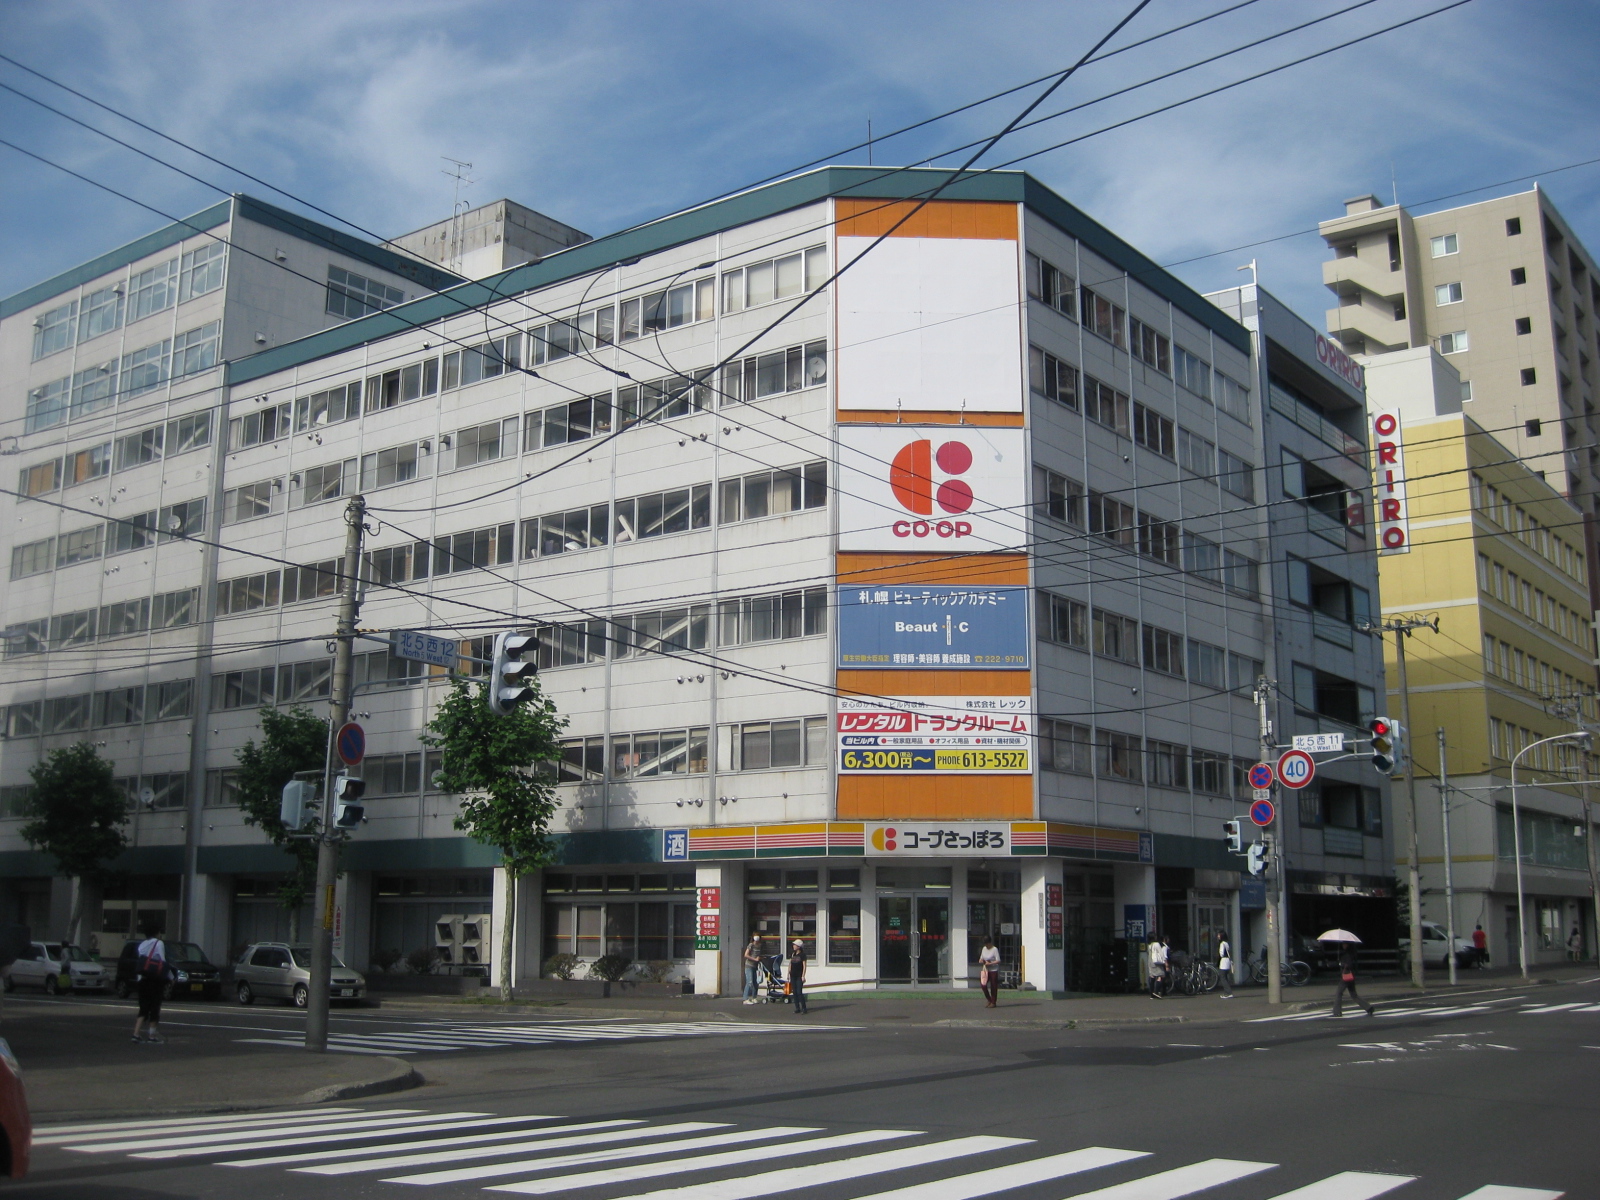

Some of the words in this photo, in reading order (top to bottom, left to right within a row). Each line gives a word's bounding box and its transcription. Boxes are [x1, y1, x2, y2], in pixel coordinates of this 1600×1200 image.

[1316, 334, 1362, 389] ORIRO
[1374, 413, 1405, 549] ORIRO
[859, 590, 889, 605] 札幌
[894, 590, 1007, 606] ビューティックアカデミー
[403, 648, 420, 658] North
[420, 651, 425, 660] 5
[426, 652, 443, 663] West
[892, 653, 941, 664] 理容師・美容師
[965, 700, 997, 709] 株式会社
[999, 699, 1027, 709] レック
[840, 714, 907, 731] レンタル
[915, 714, 1028, 732] トランクルーム
[845, 736, 876, 745] 当ビル内
[886, 737, 924, 745] 一般家庭用品
[935, 737, 970, 745] オフィス用品
[962, 752, 1025, 768] 613-5527
[1286, 760, 1305, 777] 40
[667, 835, 685, 857] 酒
[903, 830, 1004, 849] コープさっぽろ
